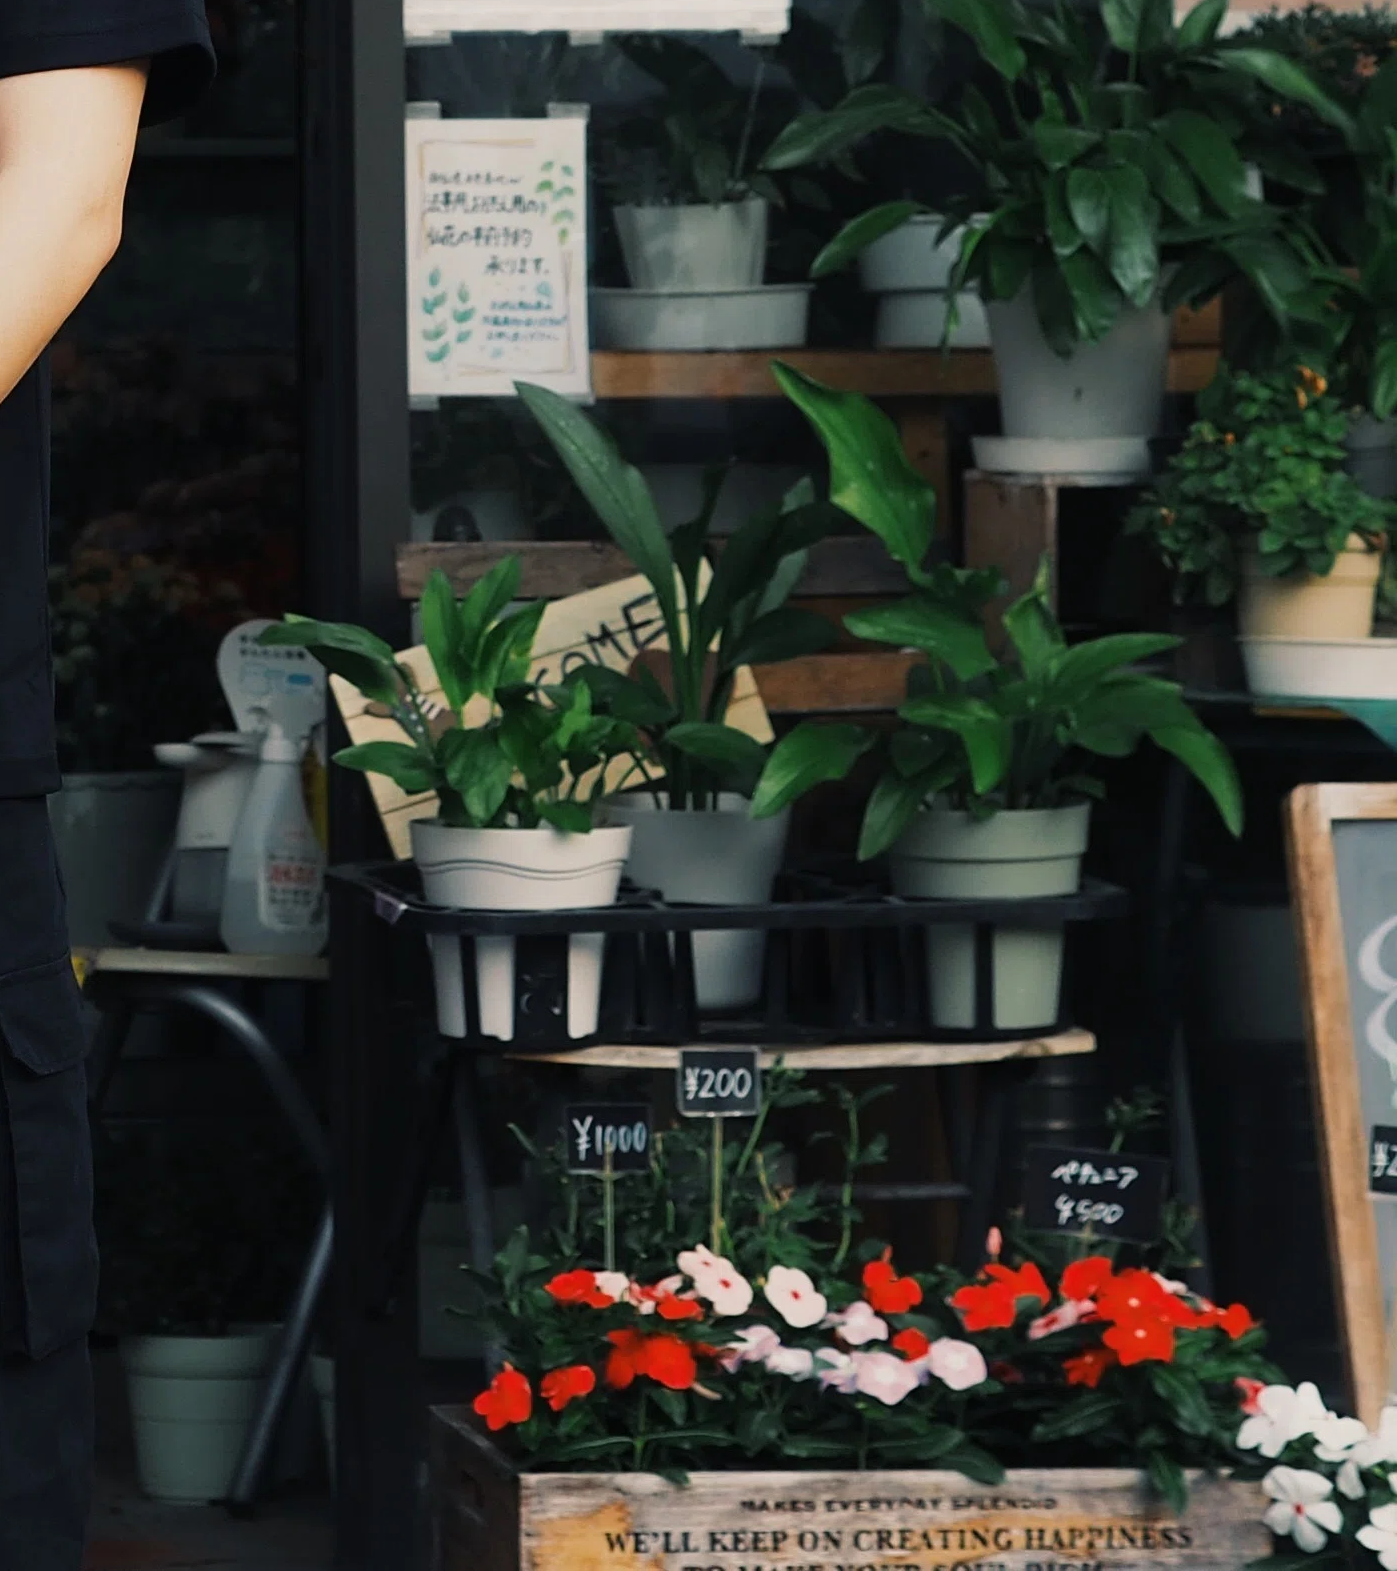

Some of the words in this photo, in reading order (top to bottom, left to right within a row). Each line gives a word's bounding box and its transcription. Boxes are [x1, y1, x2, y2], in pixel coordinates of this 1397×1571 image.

[685, 1066, 752, 1100] ¥200
[572, 1115, 647, 1161] ¥1000
[604, 1531, 701, 1554] WE'LL
[708, 1529, 788, 1553] KEEP
[797, 1530, 843, 1552] ON
[853, 1527, 1015, 1552] CREATING
[1023, 1526, 1193, 1550] HAPPINESS
